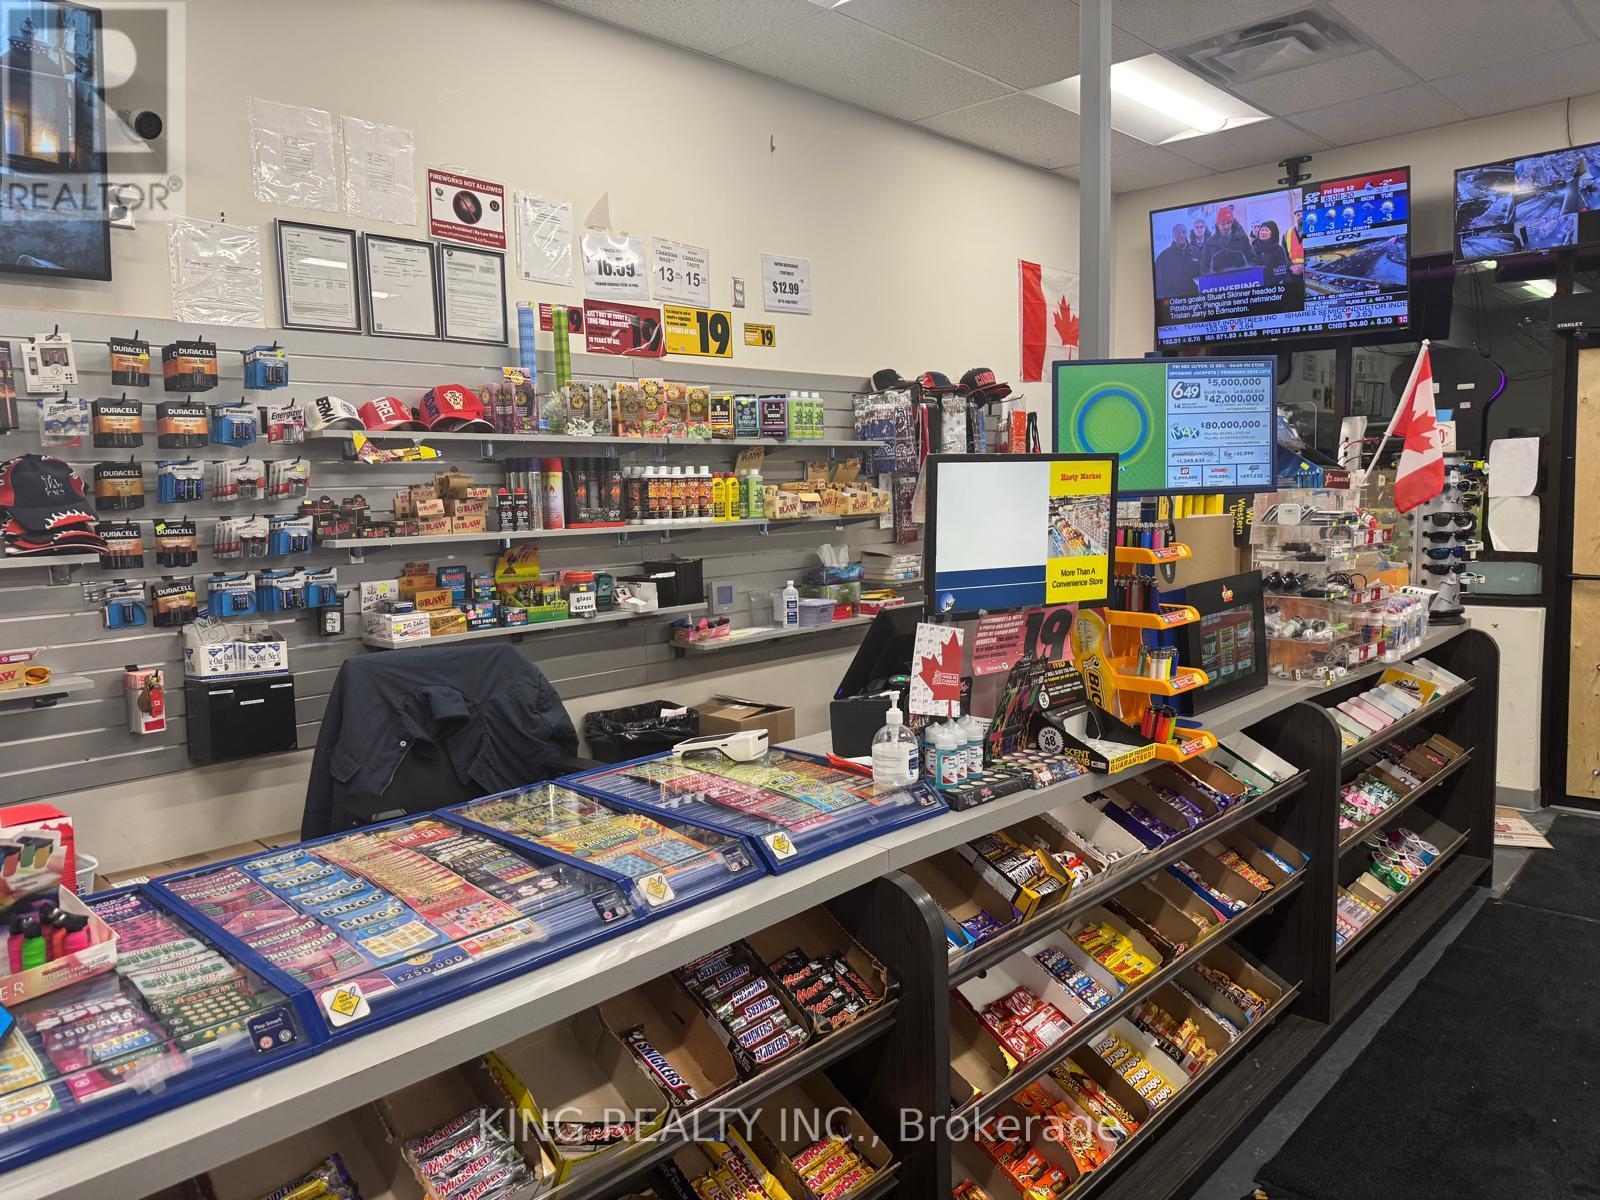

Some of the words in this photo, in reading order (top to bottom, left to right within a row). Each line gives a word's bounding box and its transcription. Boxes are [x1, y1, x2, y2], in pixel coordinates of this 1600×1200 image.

[430, 172, 462, 185] FIREWORKS
[464, 180, 476, 188] NOT
[476, 183, 503, 194] ALLOWED
[432, 221, 452, 230] Fireworks
[452, 226, 472, 234] Prohibited
[1326, 222, 1335, 230] -3
[1363, 216, 1372, 224] -5
[1382, 214, 1392, 222] -3
[1336, 232, 1361, 242] CP24
[656, 250, 678, 258] CANADIAN
[682, 255, 704, 264] CANADIAN
[659, 266, 674, 282] 13
[686, 272, 700, 287] 15
[772, 282, 800, 296] $12.99
[1170, 297, 1187, 305] Oilers
[1188, 296, 1206, 305] goalie
[1207, 293, 1226, 302] Stuart
[1228, 290, 1251, 300] Skinner
[1252, 287, 1277, 296] headed
[1204, 301, 1231, 310] Penguins
[1250, 294, 1282, 304] netminder
[1170, 311, 1191, 320] Tristan
[1192, 310, 1206, 318] Jarry
[1216, 306, 1250, 314] Edmonton.
[1184, 321, 1221, 330] TERRAVEST
[1222, 317, 1263, 326] INDUSTRIES
[1285, 310, 1316, 319] ISHARES
[1318, 303, 1386, 316] SEMICONDUCTOR
[1356, 310, 1372, 318] 3.63
[696, 311, 730, 354] 19
[1262, 328, 1281, 336] PPEM
[1376, 317, 1392, 325] 8.30
[630, 316, 660, 352] 19
[761, 328, 774, 346] 19
[113, 345, 146, 354] DURACELL
[178, 348, 214, 356] DURACELL
[1208, 378, 1261, 387] $5,000,000
[1204, 394, 1264, 404] $42,000,000
[168, 408, 204, 416] DURACELL
[272, 408, 303, 420] Energizer
[1200, 420, 1260, 430] $80,000,000
[742, 450, 762, 462] RAW
[1060, 473, 1079, 482] Hasty
[413, 490, 434, 498] RAW
[472, 488, 488, 496] RAW
[421, 504, 439, 512] RAW
[464, 502, 484, 513] RAW
[779, 502, 798, 514] RAW
[802, 501, 818, 510] RAW
[852, 499, 868, 510] RAW
[873, 498, 886, 508] RAW
[1236, 498, 1246, 535] Western
[325, 522, 350, 536] RAW
[425, 520, 447, 531] RAW
[460, 520, 481, 529] RAW
[101, 530, 139, 538] DURACELL
[157, 528, 194, 537] DURACELL
[368, 529, 384, 538] RAW
[1061, 569, 1076, 577] More
[1076, 568, 1090, 576] Than
[1052, 578, 1088, 589] Convenience
[1089, 578, 1104, 586] Store
[158, 585, 192, 596] DURACELL
[363, 593, 388, 603] ZIG-ZAG
[423, 594, 447, 606] RAW
[576, 594, 592, 602] glass
[403, 620, 424, 630] ZIG-ZAG
[1024, 608, 1072, 661] 19
[214, 656, 223, 664] Out
[1088, 672, 1104, 708] BIC
[1042, 727, 1056, 738] LASTS
[1044, 736, 1056, 747] 48
[1064, 748, 1090, 759] SCENT
[1110, 751, 1154, 772] GUARANTEED!
[465, 850, 502, 863] MILLION
[274, 868, 334, 888] BINGO
[302, 883, 364, 905] BINGO
[320, 894, 384, 916] BINGO
[339, 907, 403, 930] BINGO
[717, 964, 749, 987] SNICKERS
[782, 966, 812, 987] Mars
[796, 980, 824, 1002] Mars
[745, 995, 780, 1019] SNICKERS
[254, 1022, 265, 1030] Play
[266, 1018, 282, 1028] Smart
[738, 1019, 773, 1048] SNICKERS
[755, 1033, 789, 1062] SNICKERS
[640, 1042, 685, 1088] SNICKERS
[428, 1134, 481, 1177] Musketeers
[440, 1153, 494, 1196] Musketeers
